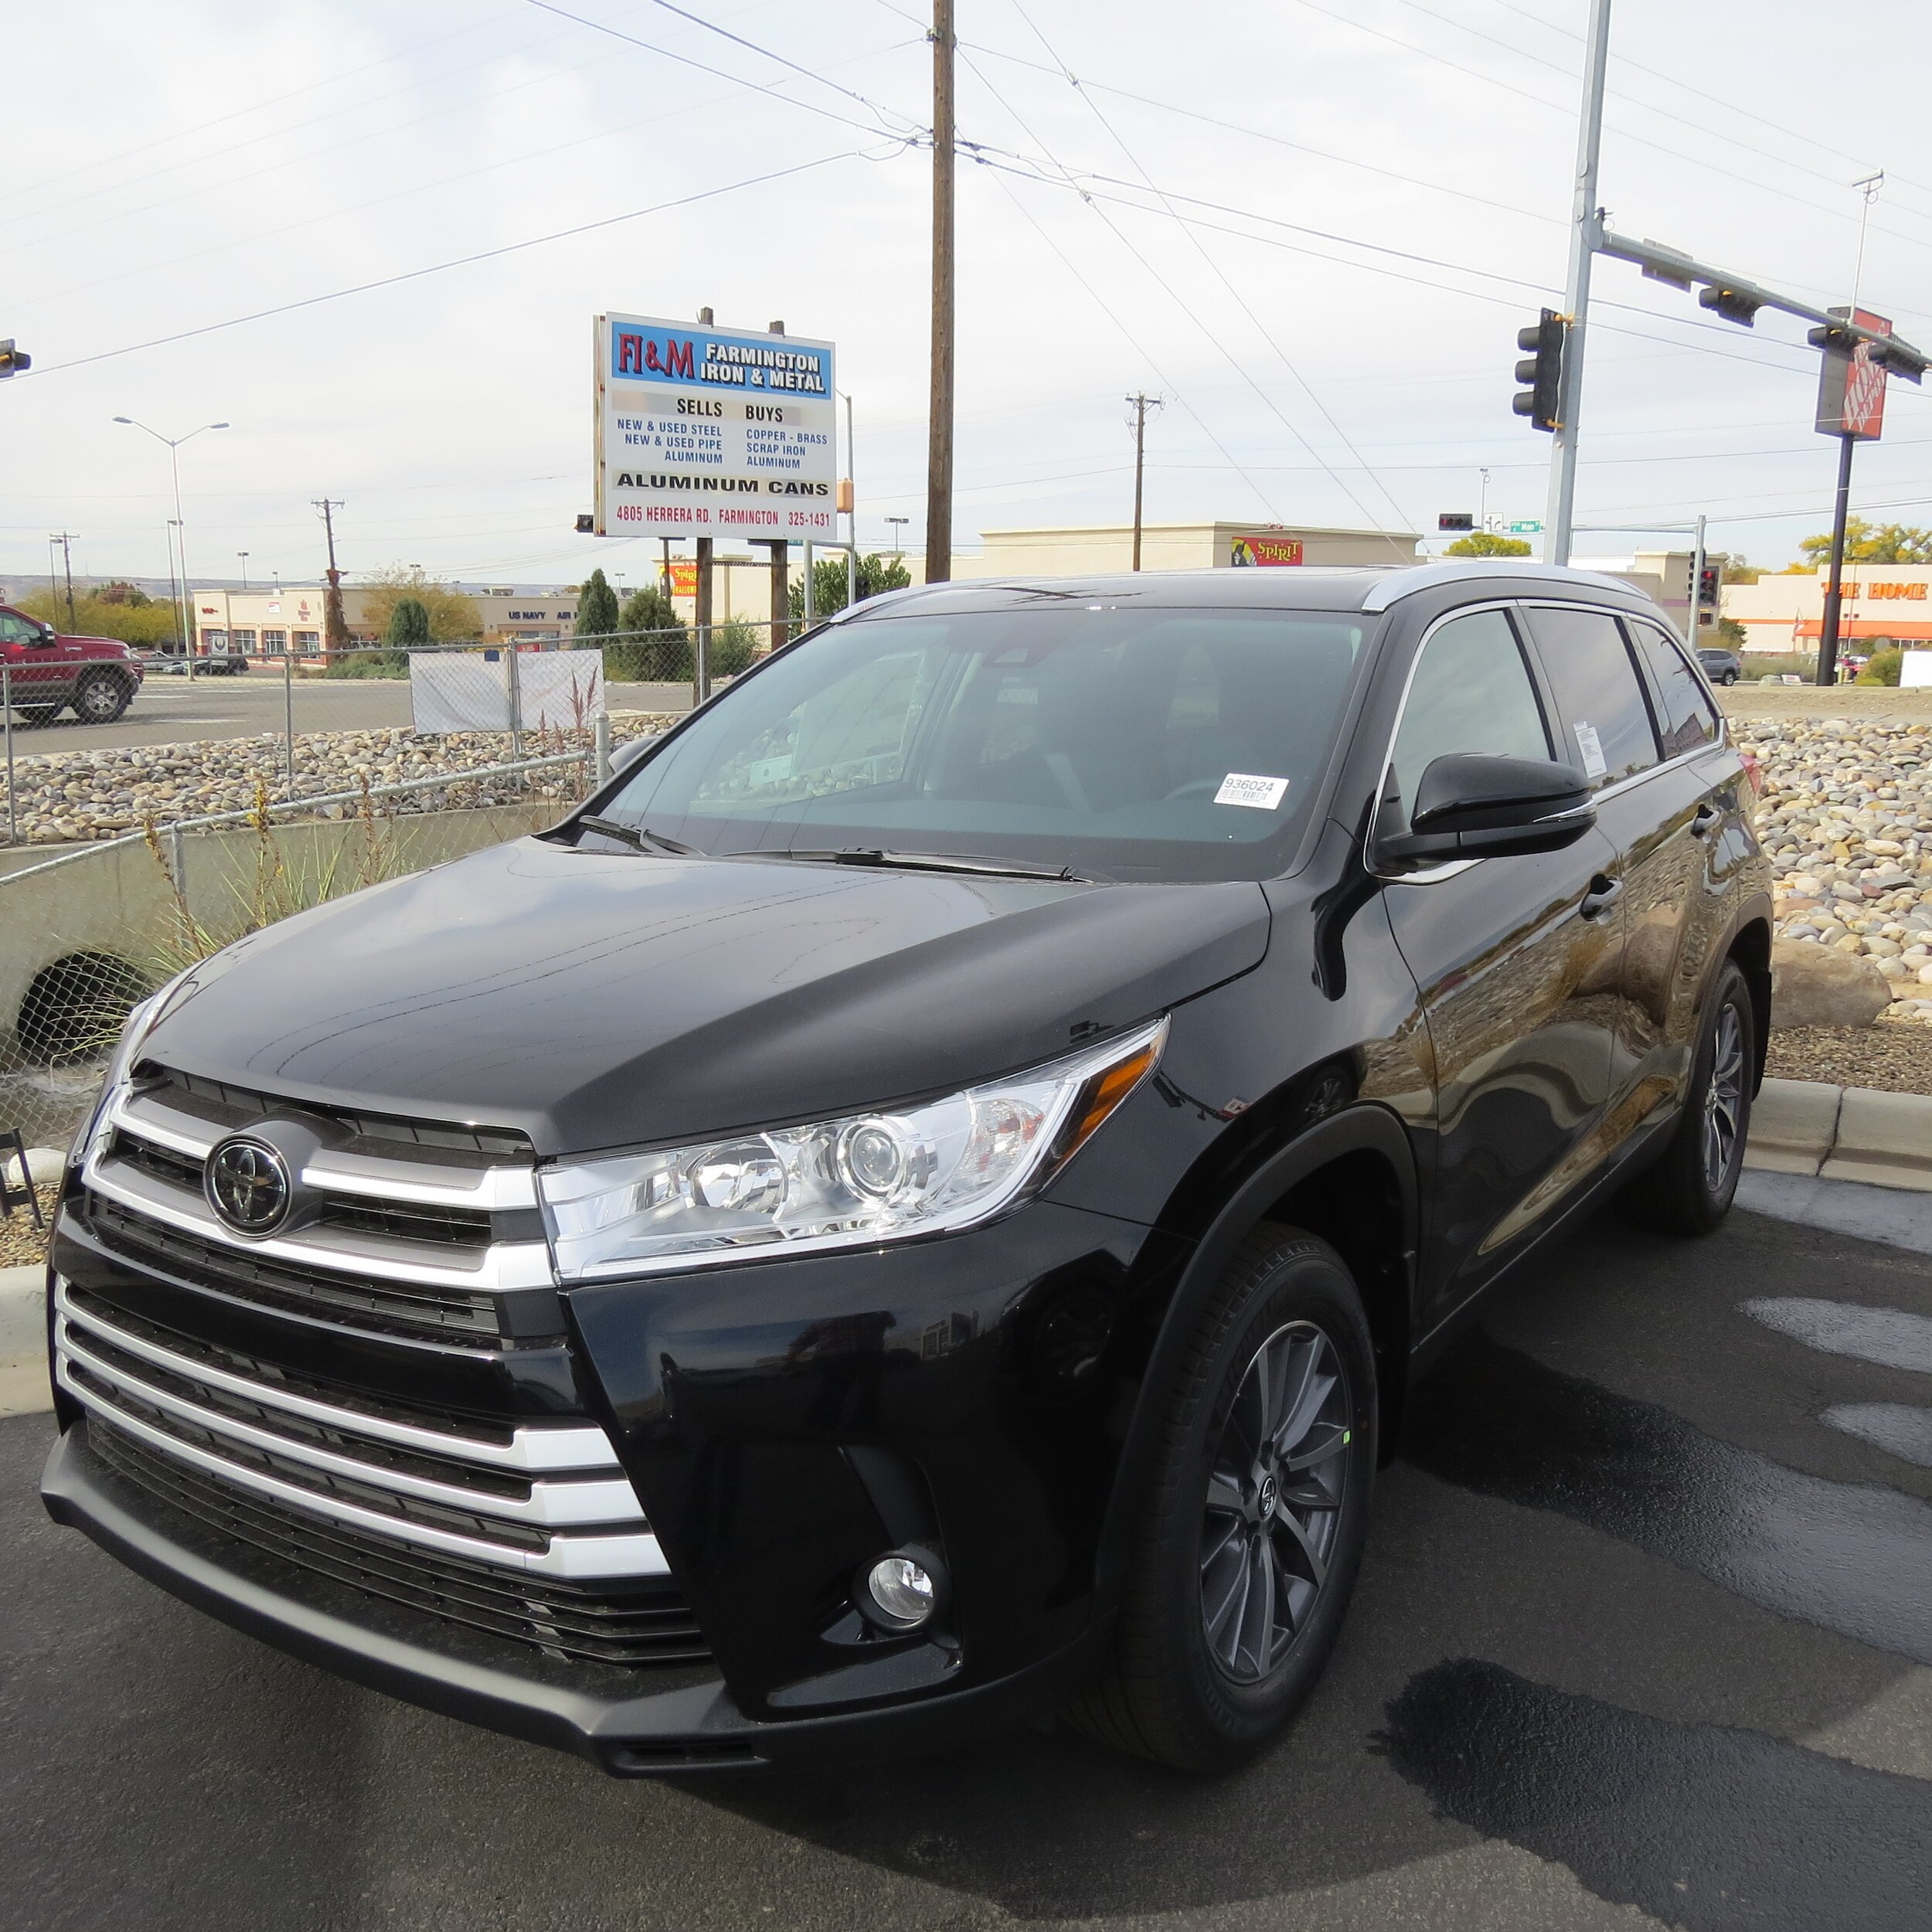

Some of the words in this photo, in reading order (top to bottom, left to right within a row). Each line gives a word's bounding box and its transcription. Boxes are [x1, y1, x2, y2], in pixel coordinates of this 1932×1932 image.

[706, 342, 820, 372] FARMINGTON
[700, 362, 744, 386] IRON
[750, 368, 764, 386] &
[770, 370, 826, 393] METAL
[677, 398, 723, 417] SELLS
[745, 404, 783, 423] BUYS
[617, 418, 642, 431] NEW
[648, 421, 655, 432] &
[659, 421, 687, 434] USED
[692, 423, 722, 437] STEEL
[625, 434, 650, 446] NEW
[655, 435, 662, 447] &
[667, 436, 694, 448] USED
[699, 438, 722, 451] PIPE
[747, 429, 786, 442] COPPER
[797, 433, 828, 445] BRASS
[665, 451, 723, 464] ALUMINUM
[747, 442, 779, 454] SCRAP
[783, 445, 806, 456] IRON
[747, 456, 801, 469] ALUMINUM
[617, 474, 759, 493] ALUMINUM
[768, 481, 828, 496] CANS
[617, 505, 642, 522] 4805
[647, 507, 692, 523] HERRERA
[696, 509, 712, 523] RD.
[719, 509, 779, 526] FARMINGTON
[788, 512, 830, 527] 325-1431
[1257, 542, 1299, 561] SPIRIT
[675, 568, 697, 582] SPIRI
[1867, 583, 1929, 600] HOME
[1224, 778, 1274, 793] 936024
